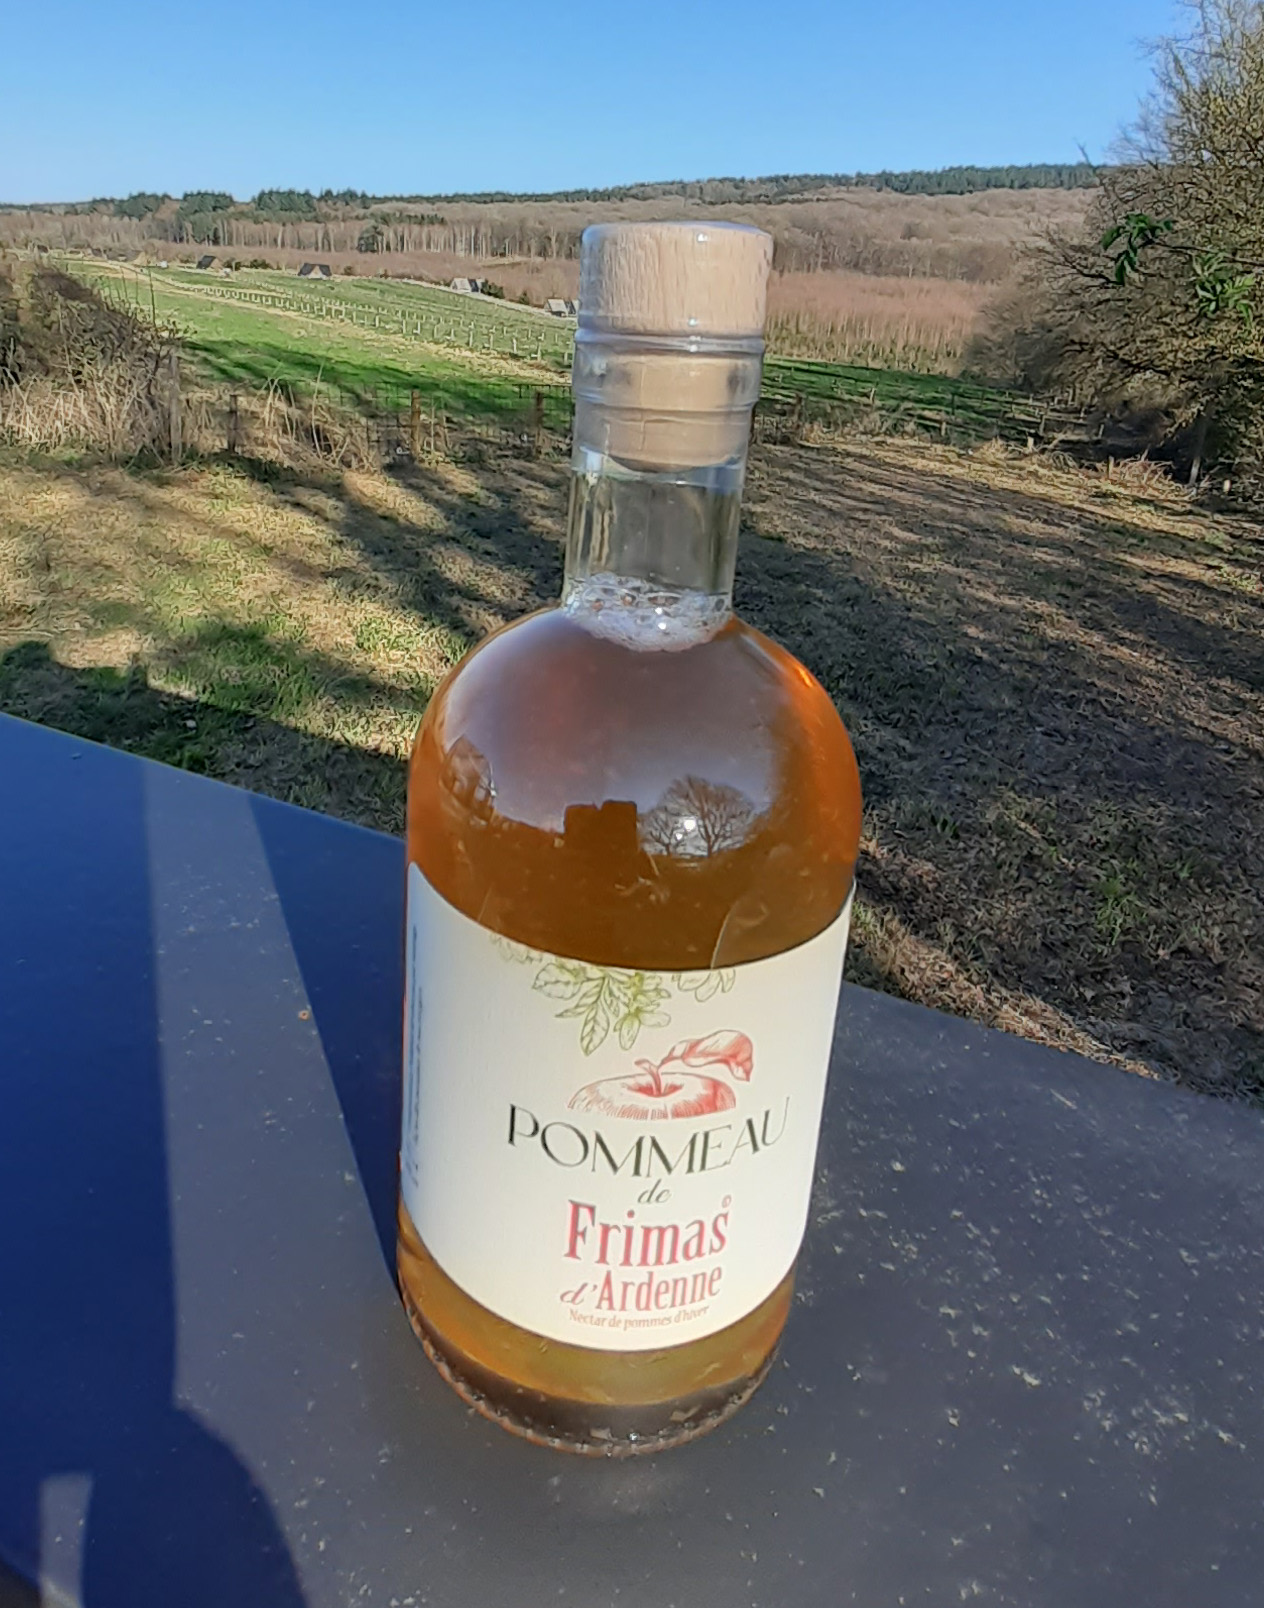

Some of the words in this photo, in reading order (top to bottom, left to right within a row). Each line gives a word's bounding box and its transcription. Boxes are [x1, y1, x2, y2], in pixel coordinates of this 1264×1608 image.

[507, 1096, 791, 1178] POMMEAU
[637, 1178, 672, 1205] de
[563, 1199, 731, 1267] Frimas
[559, 1265, 723, 1312] d'Ardenne
[569, 1308, 606, 1327] Nectar
[608, 1314, 622, 1329] de
[623, 1314, 672, 1332] pommes
